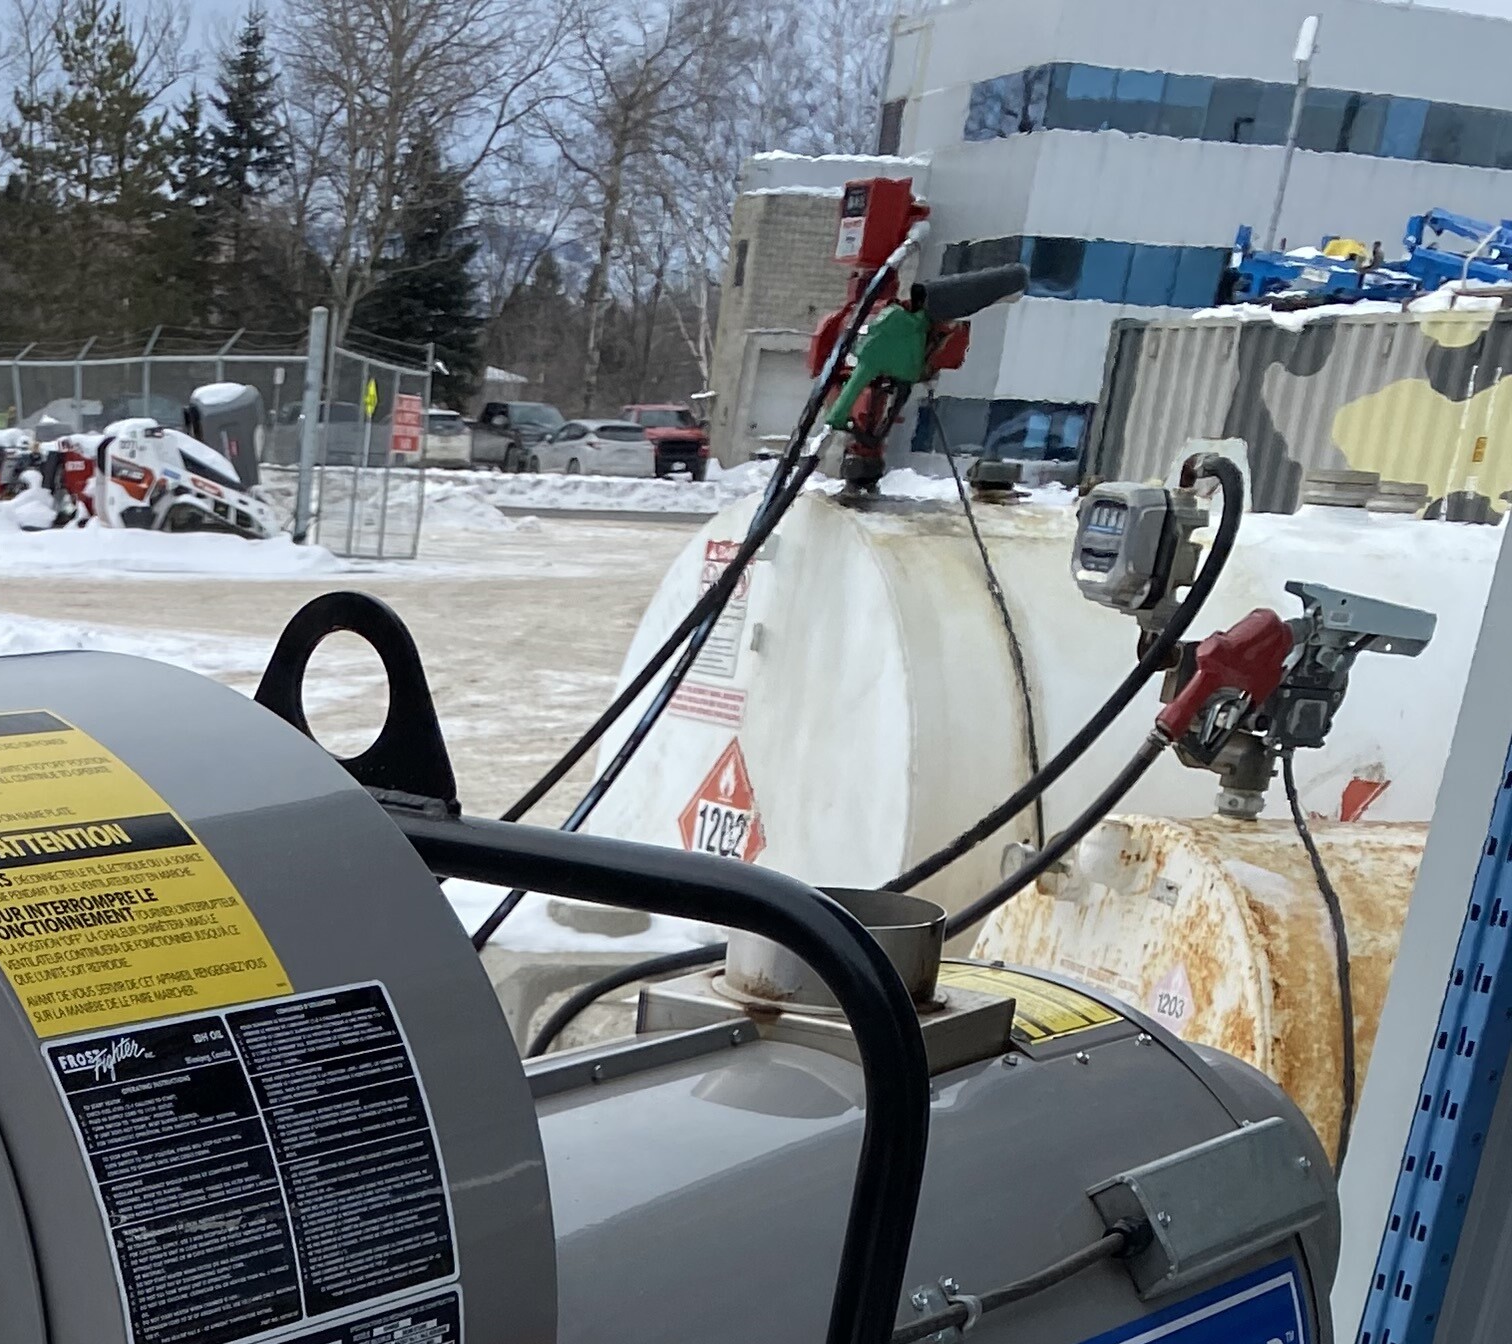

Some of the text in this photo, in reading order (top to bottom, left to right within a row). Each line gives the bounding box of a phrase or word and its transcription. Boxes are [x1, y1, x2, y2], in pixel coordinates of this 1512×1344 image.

[698, 804, 747, 858] 1202
[23, 890, 138, 918] INTERROMPRE
[134, 887, 158, 902] LE
[1156, 993, 1185, 1019] 1203
[92, 1037, 145, 1081] Fighter
